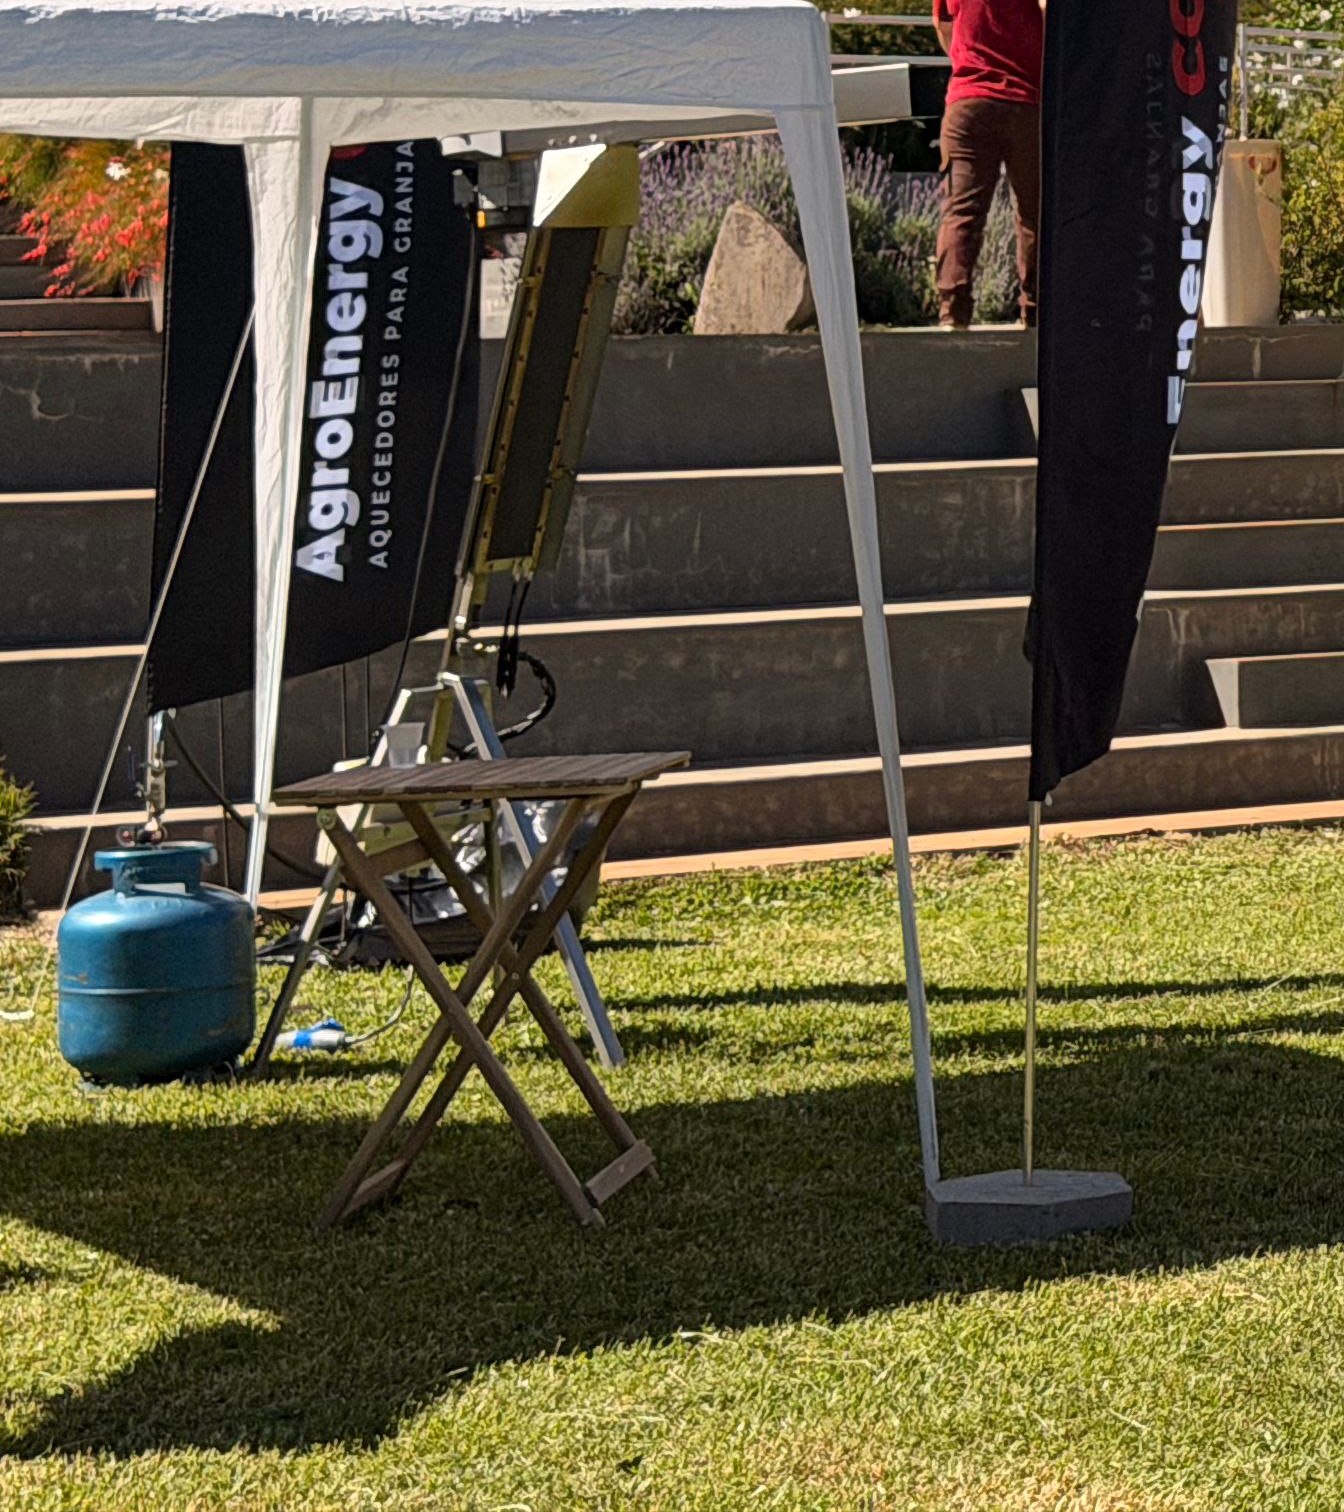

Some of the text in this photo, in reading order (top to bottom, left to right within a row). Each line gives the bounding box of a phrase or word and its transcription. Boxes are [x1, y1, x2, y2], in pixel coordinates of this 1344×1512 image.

[295, 176, 385, 582] AgroEnergy
[383, 266, 410, 341] PARA
[368, 355, 400, 569] AQUECEDORES
